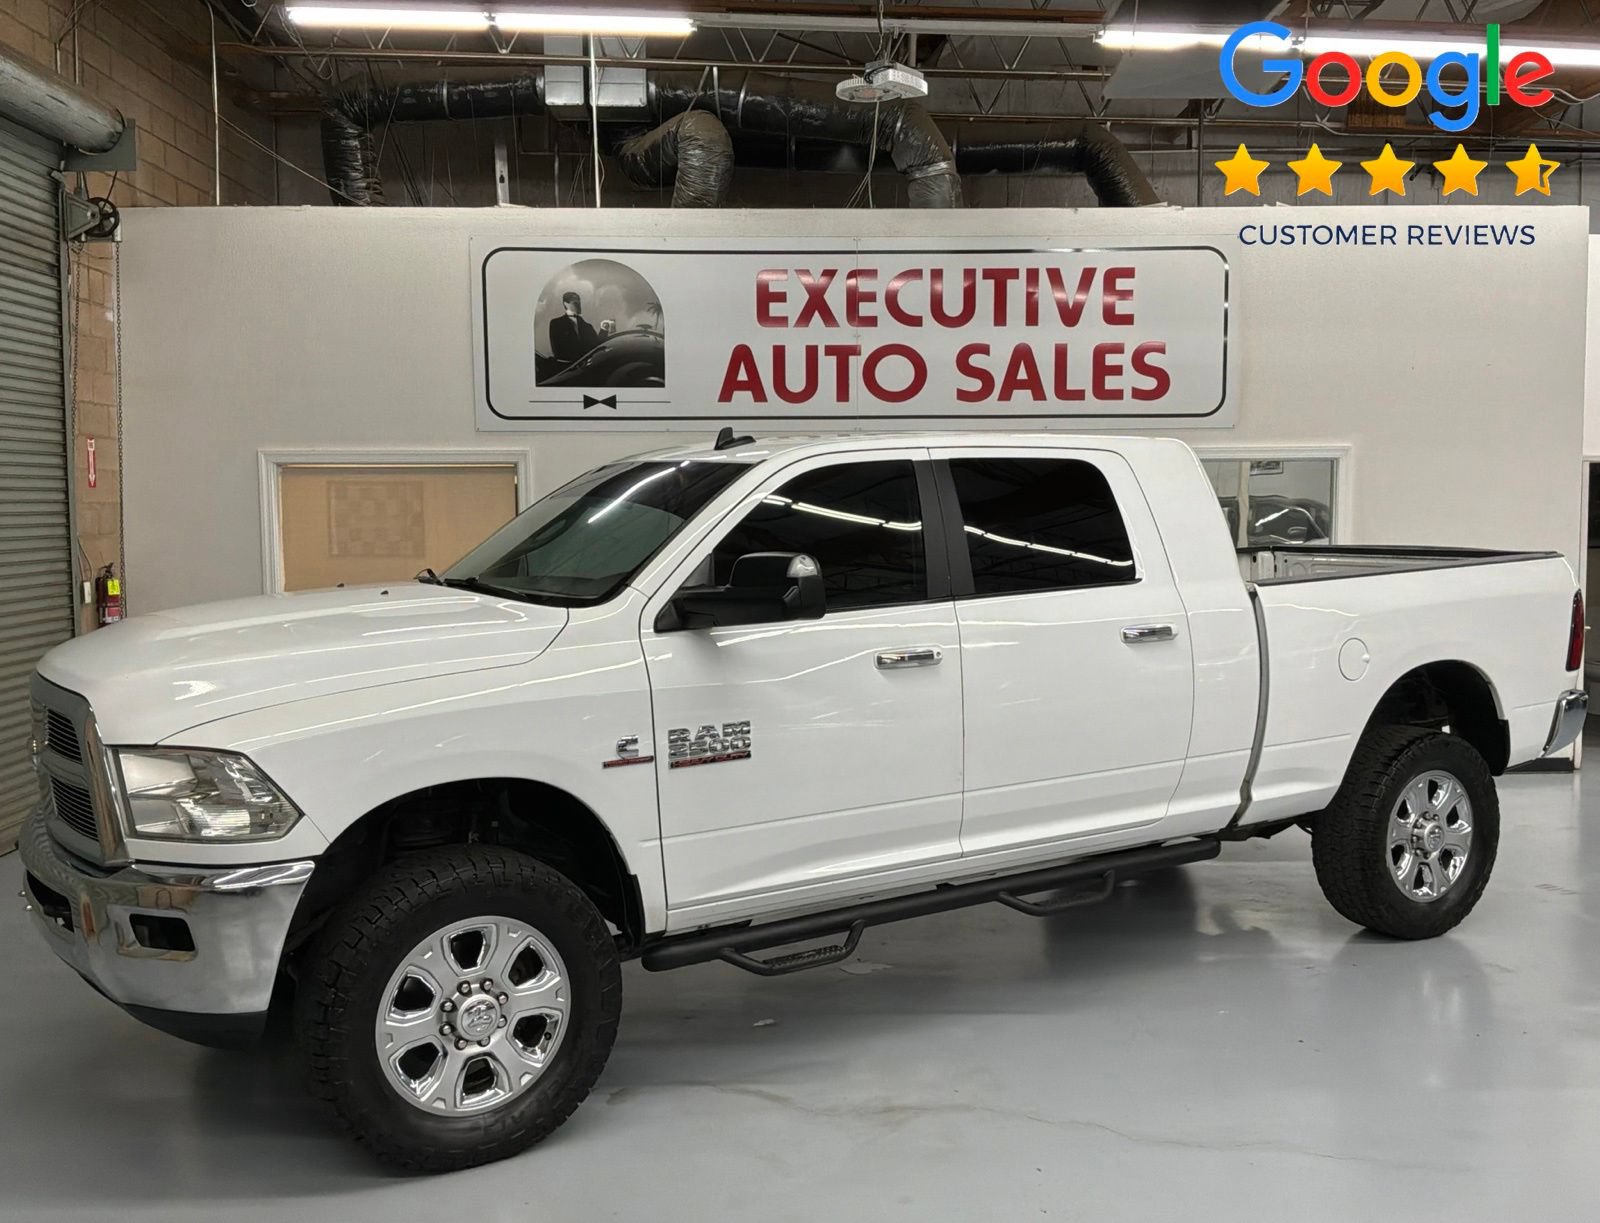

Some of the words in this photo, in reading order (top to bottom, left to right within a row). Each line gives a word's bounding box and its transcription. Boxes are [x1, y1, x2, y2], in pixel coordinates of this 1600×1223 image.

[756, 267, 1136, 328] EXECUTIVE
[717, 342, 928, 404] AUTO
[955, 341, 1171, 402] SALES
[668, 720, 751, 744] RAM
[668, 736, 751, 759] 2500
